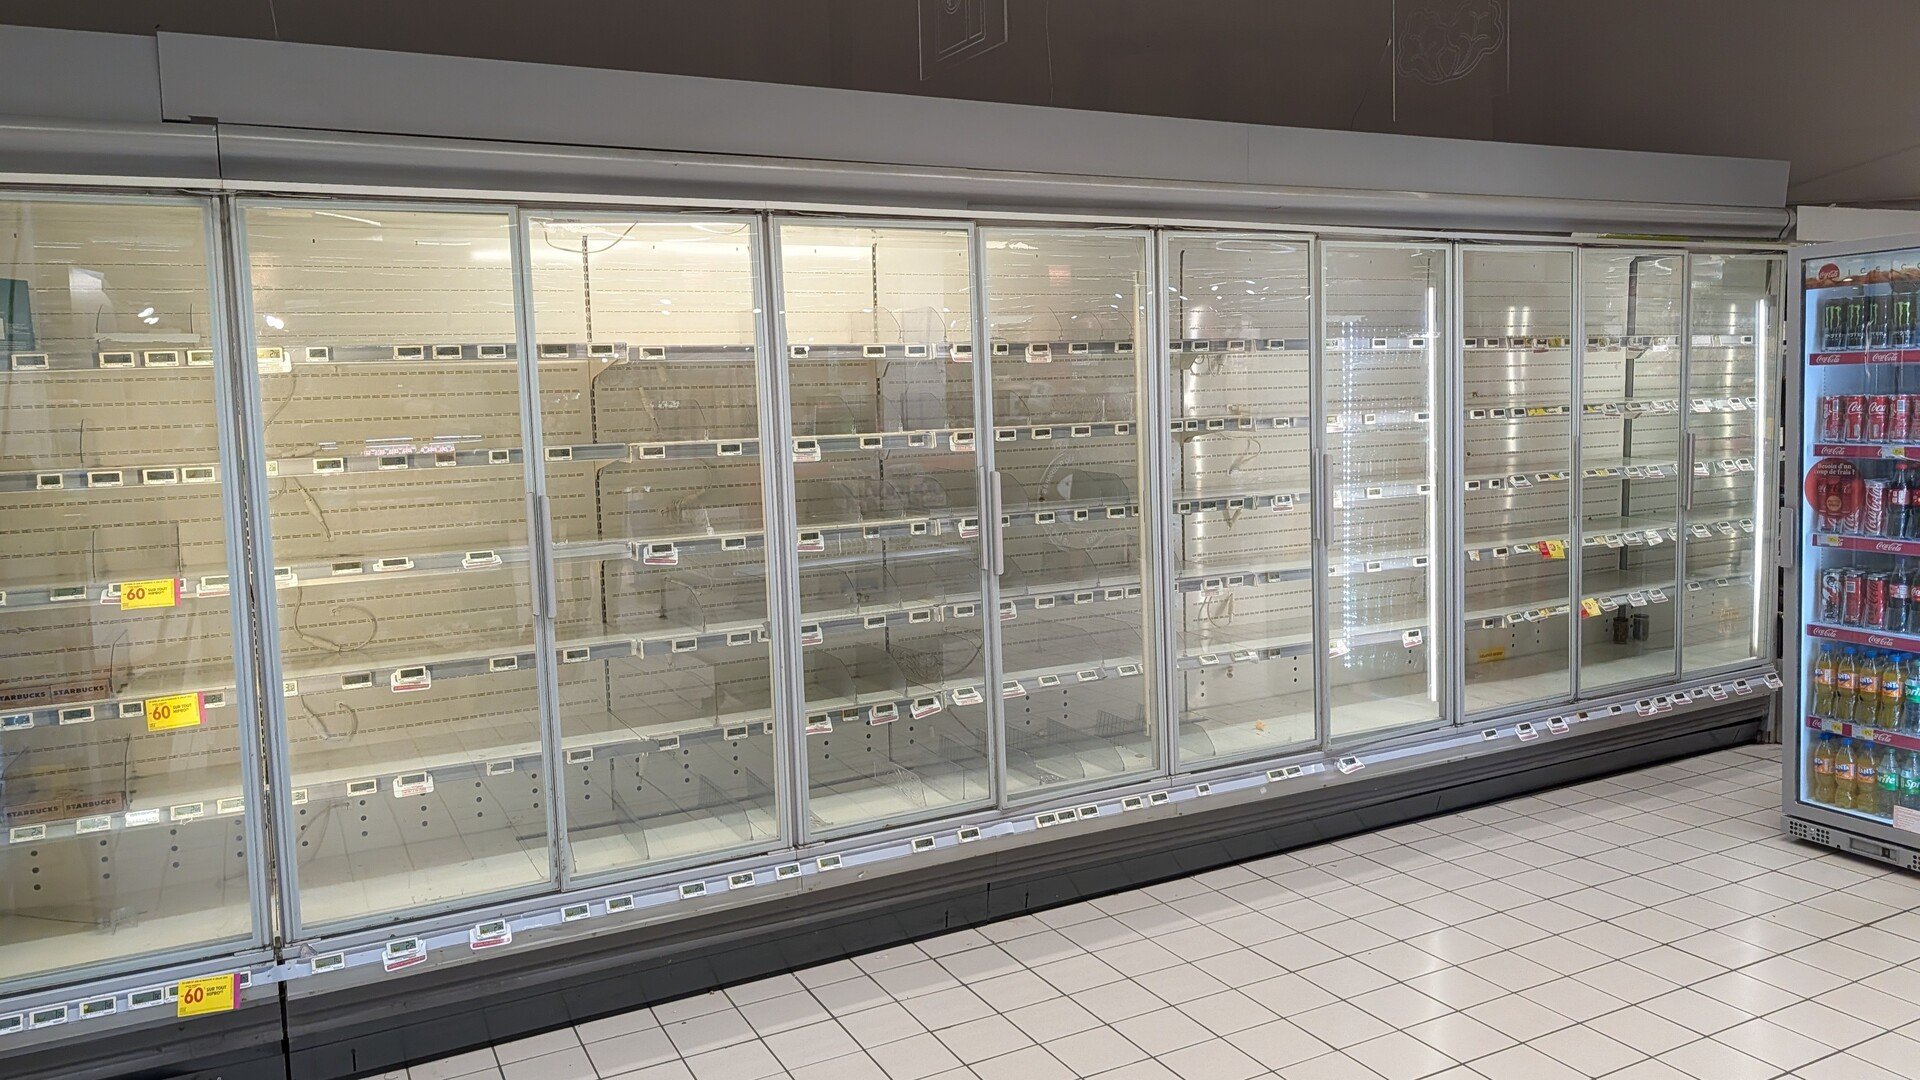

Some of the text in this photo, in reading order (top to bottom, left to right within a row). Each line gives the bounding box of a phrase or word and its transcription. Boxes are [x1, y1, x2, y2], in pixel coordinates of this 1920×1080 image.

[0, 691, 46, 701] TARBUCKS
[53, 685, 104, 697] STARBUCKS
[66, 798, 117, 810] STARBUCKS
[6, 806, 59, 818] STARBUCKS
